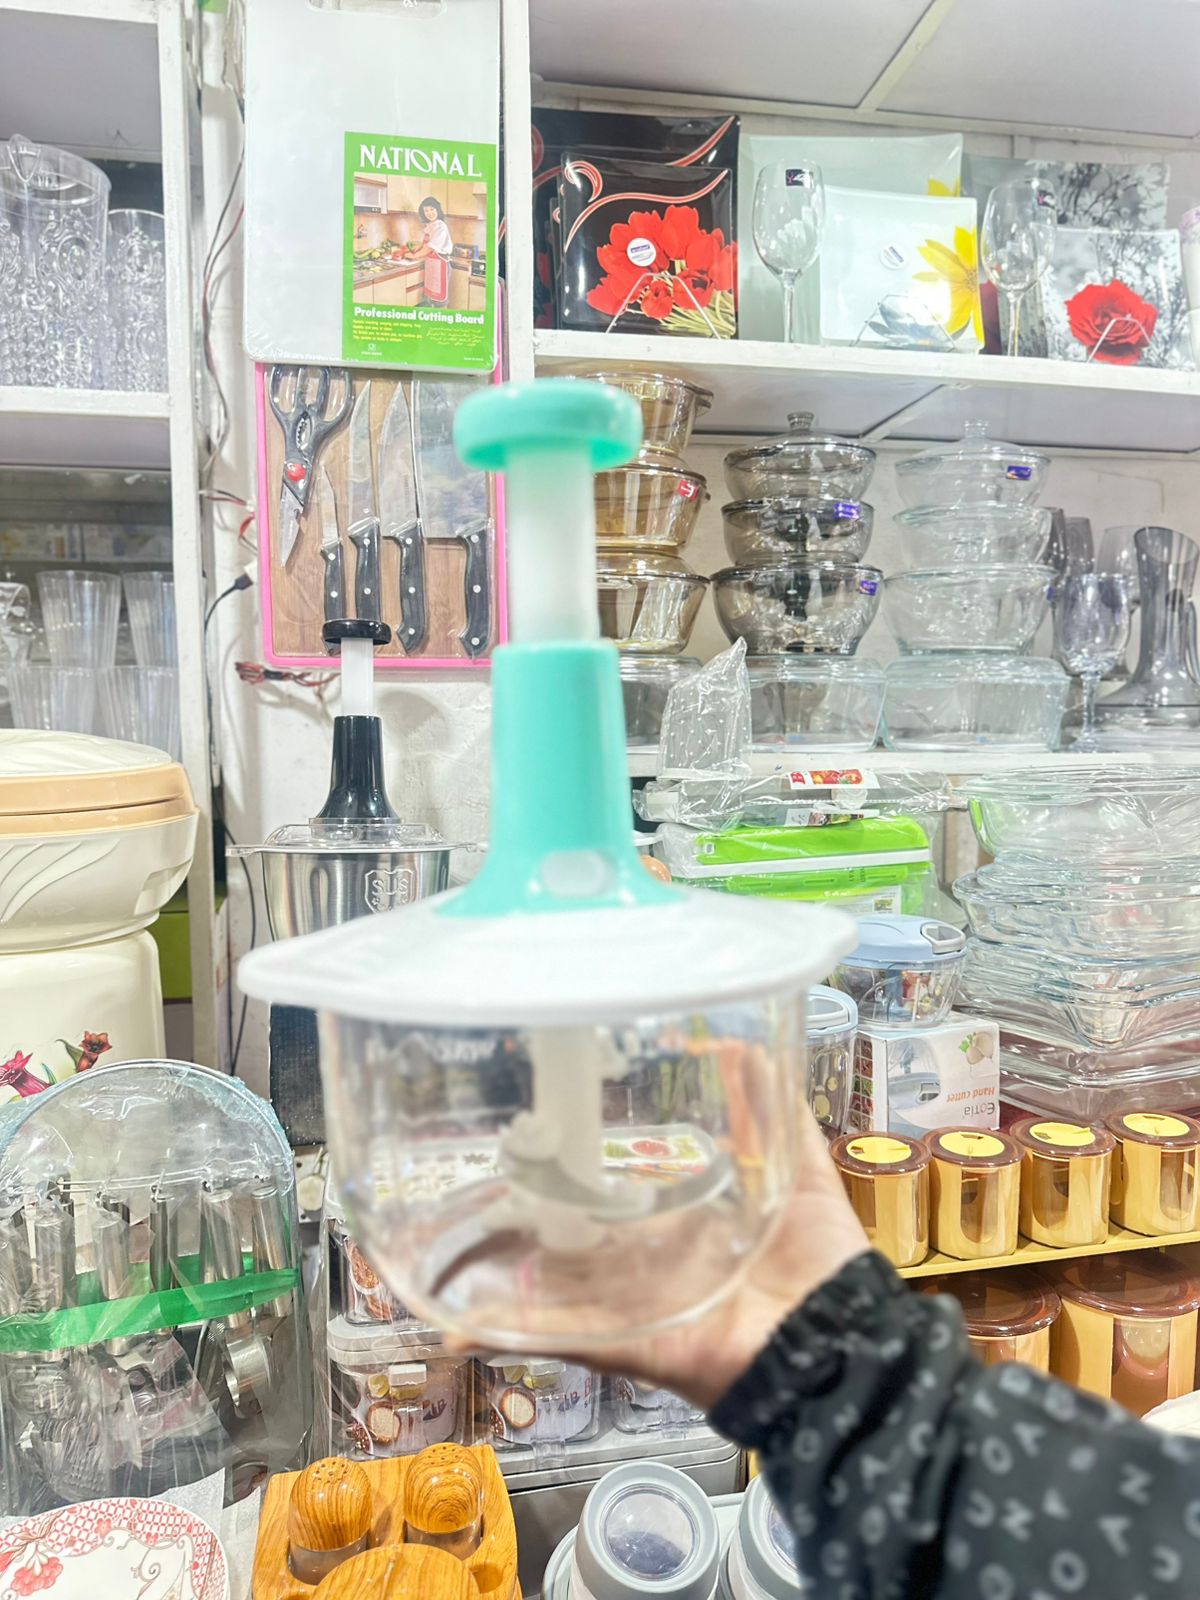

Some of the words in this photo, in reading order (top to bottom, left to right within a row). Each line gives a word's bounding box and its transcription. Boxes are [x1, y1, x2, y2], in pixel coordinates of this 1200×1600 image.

[359, 144, 482, 177] NATIONAL
[355, 307, 416, 321] Professional
[418, 310, 454, 324] Cutting
[455, 313, 484, 324] Board
[371, 878, 408, 896] SUS
[947, 1091, 971, 1102] cutter
[973, 1087, 995, 1098] Hand
